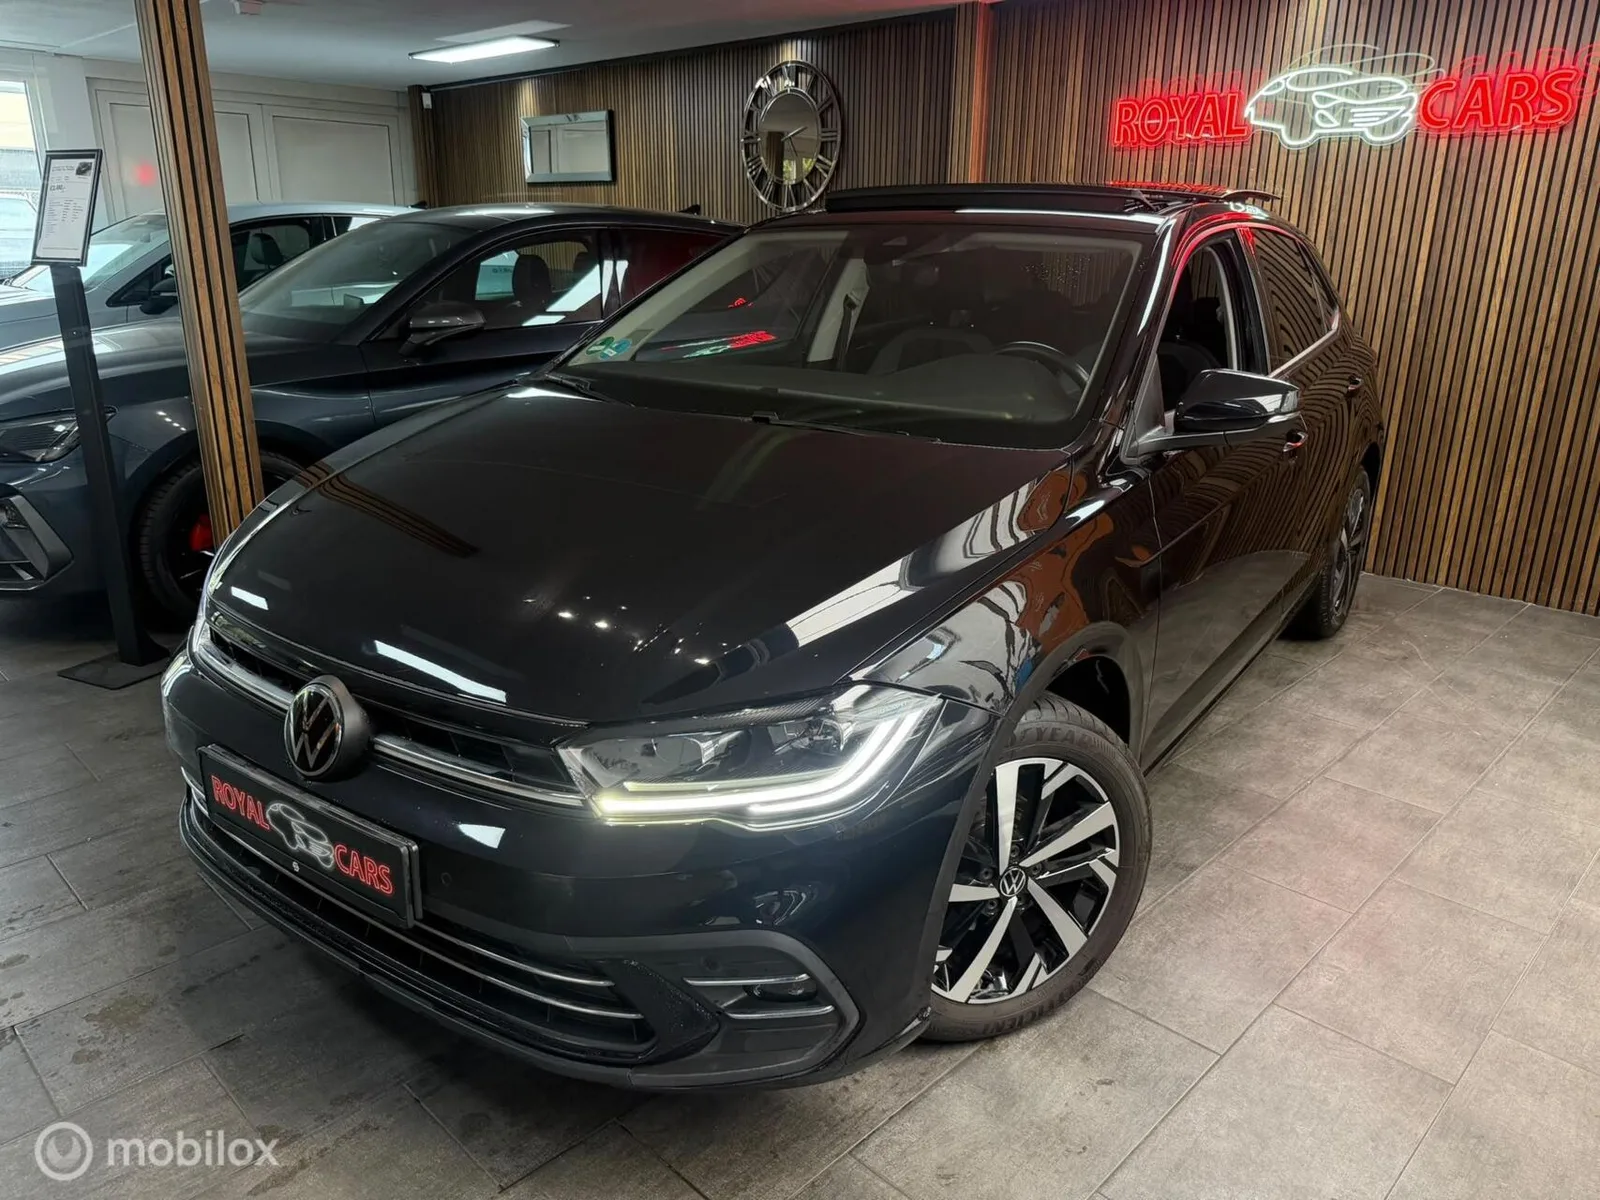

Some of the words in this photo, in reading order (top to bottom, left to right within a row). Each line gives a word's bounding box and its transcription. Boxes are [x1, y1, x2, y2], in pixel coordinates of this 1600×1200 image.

[1114, 92, 1248, 144] ROYAL
[1419, 68, 1578, 130] CARS
[211, 775, 271, 830] ROYAL
[334, 844, 394, 895] CARS
